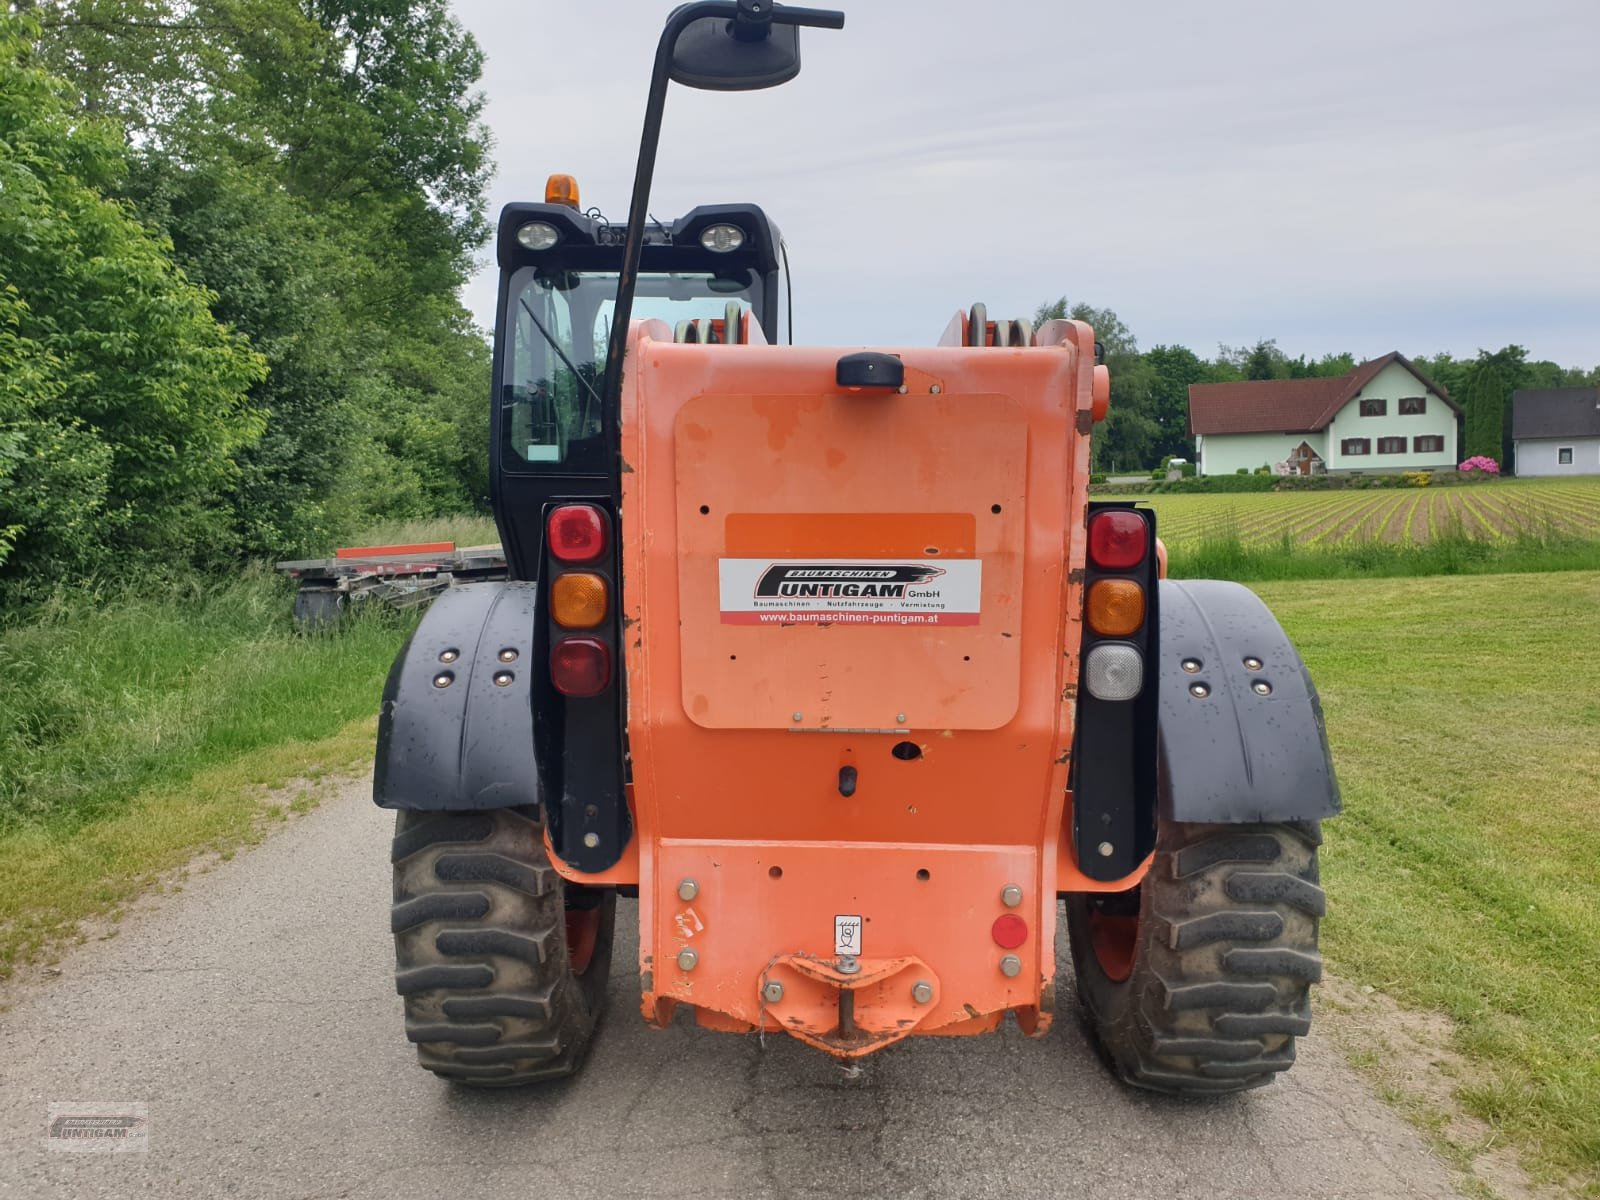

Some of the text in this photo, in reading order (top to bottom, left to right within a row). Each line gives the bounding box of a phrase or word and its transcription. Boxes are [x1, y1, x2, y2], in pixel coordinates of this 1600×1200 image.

[790, 570, 890, 578] BAUMASCHINEN
[908, 590, 940, 598] GmbH
[827, 601, 884, 609] Nutzfahrzeuge
[760, 612, 939, 624] www.baumaschinen-puntigam.at
